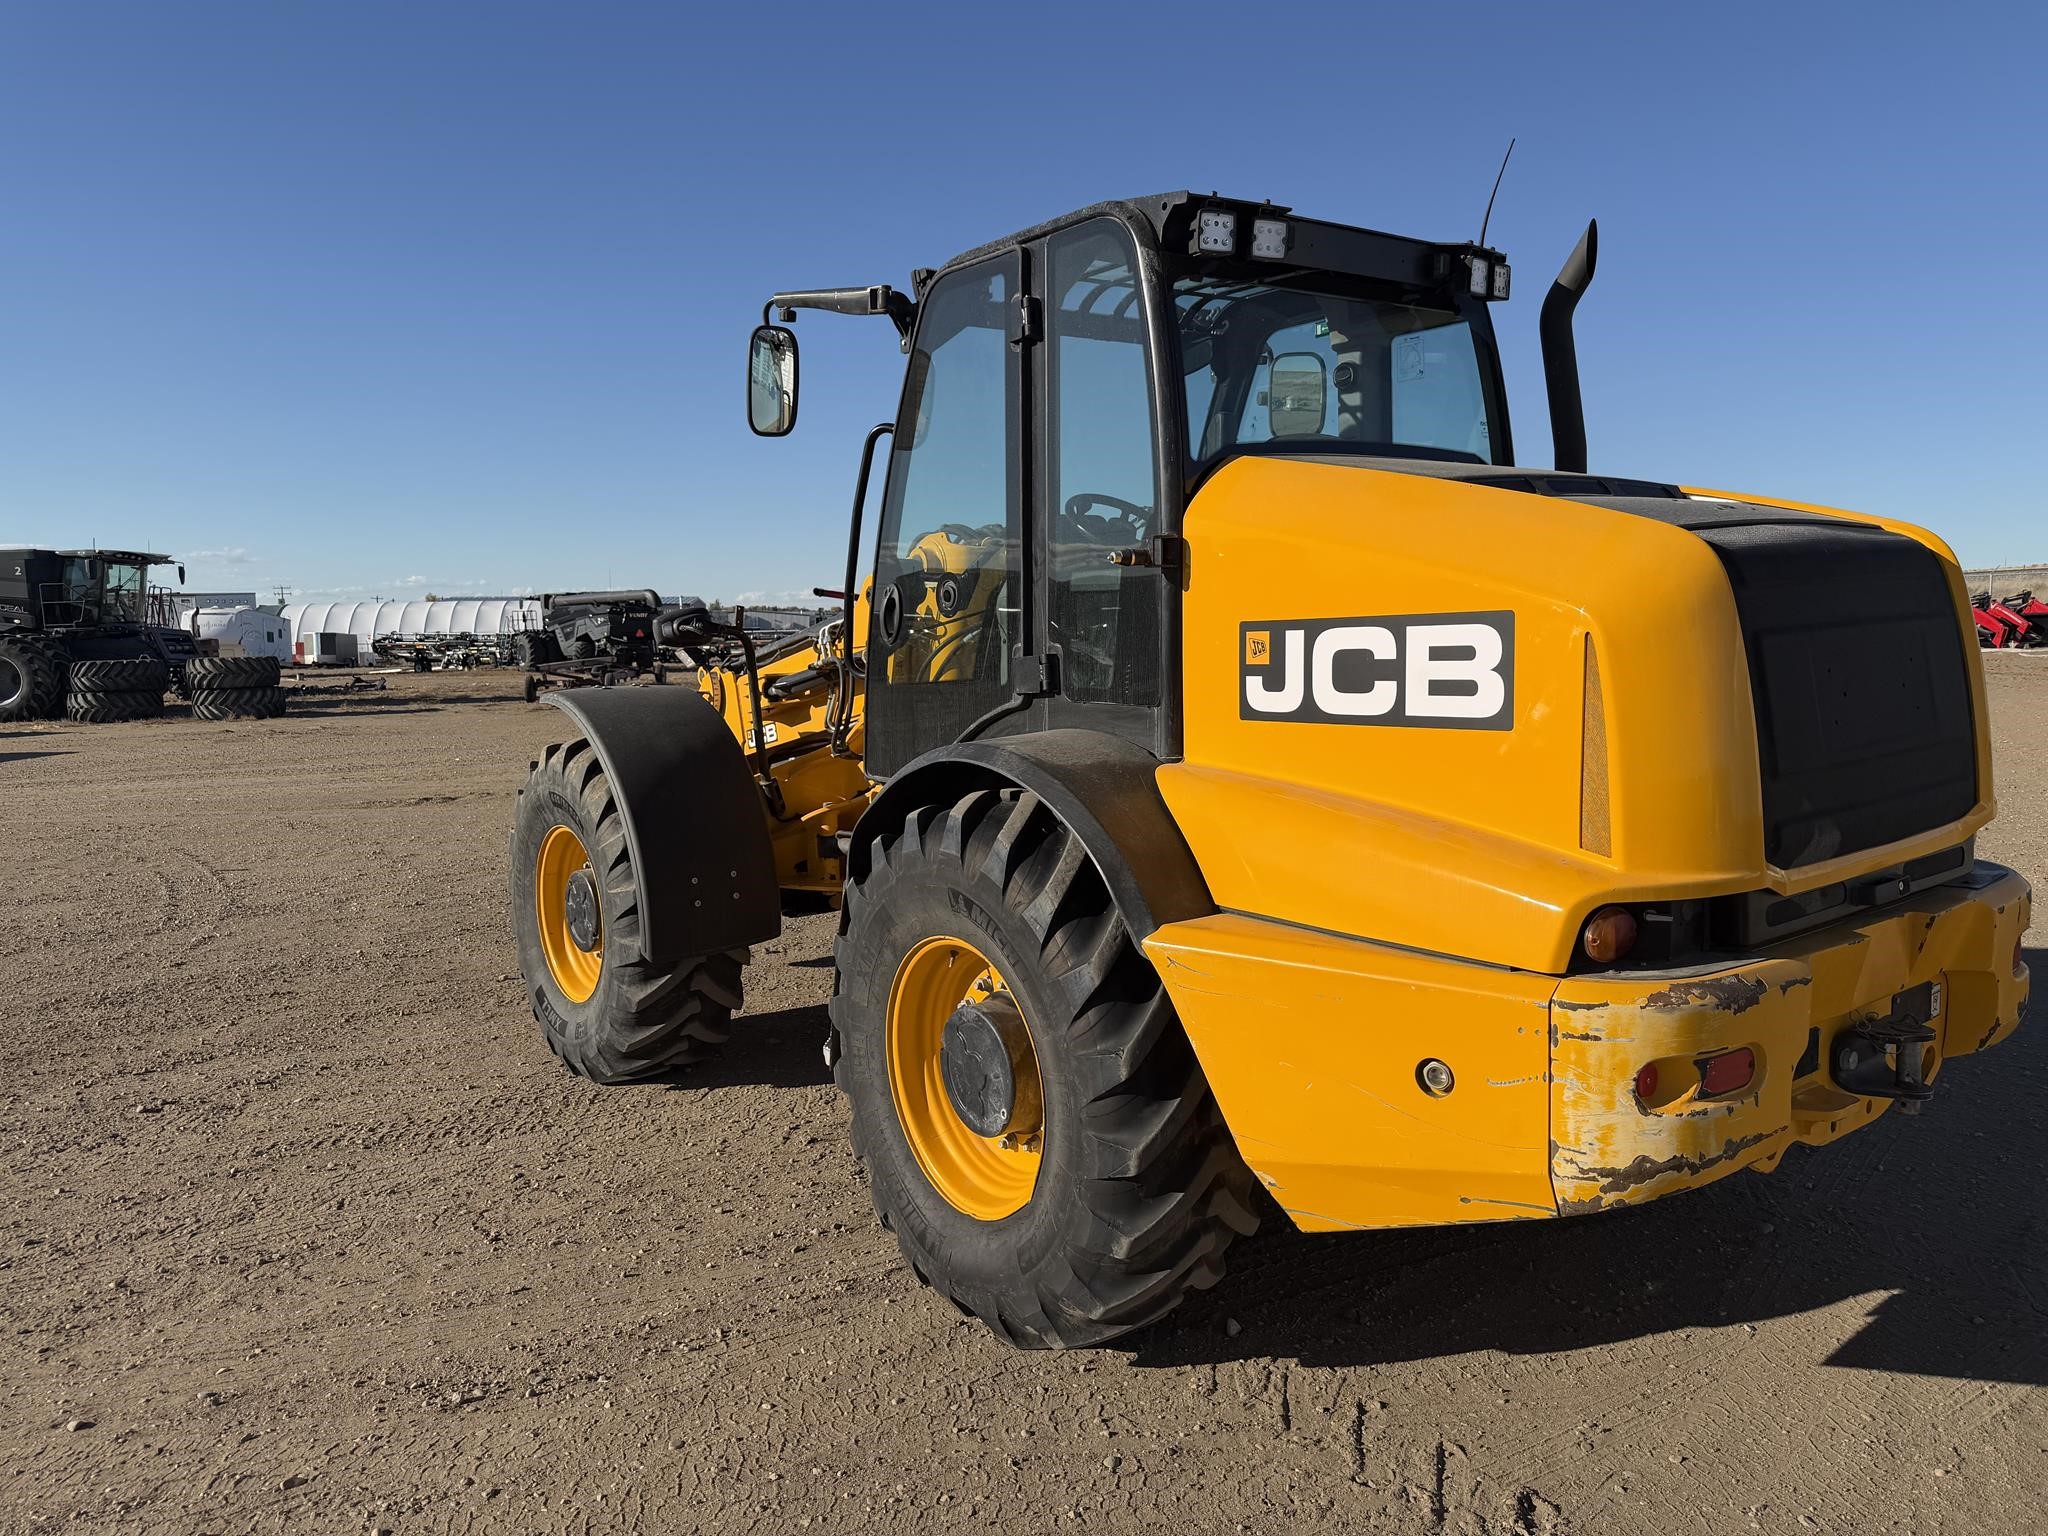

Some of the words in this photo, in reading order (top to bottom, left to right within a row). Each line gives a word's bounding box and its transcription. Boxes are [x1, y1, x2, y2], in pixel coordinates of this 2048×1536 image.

[14, 566, 22, 575] 2
[1252, 640, 1266, 656] JCB
[1246, 624, 1505, 718] JCB
[748, 723, 777, 748] JB
